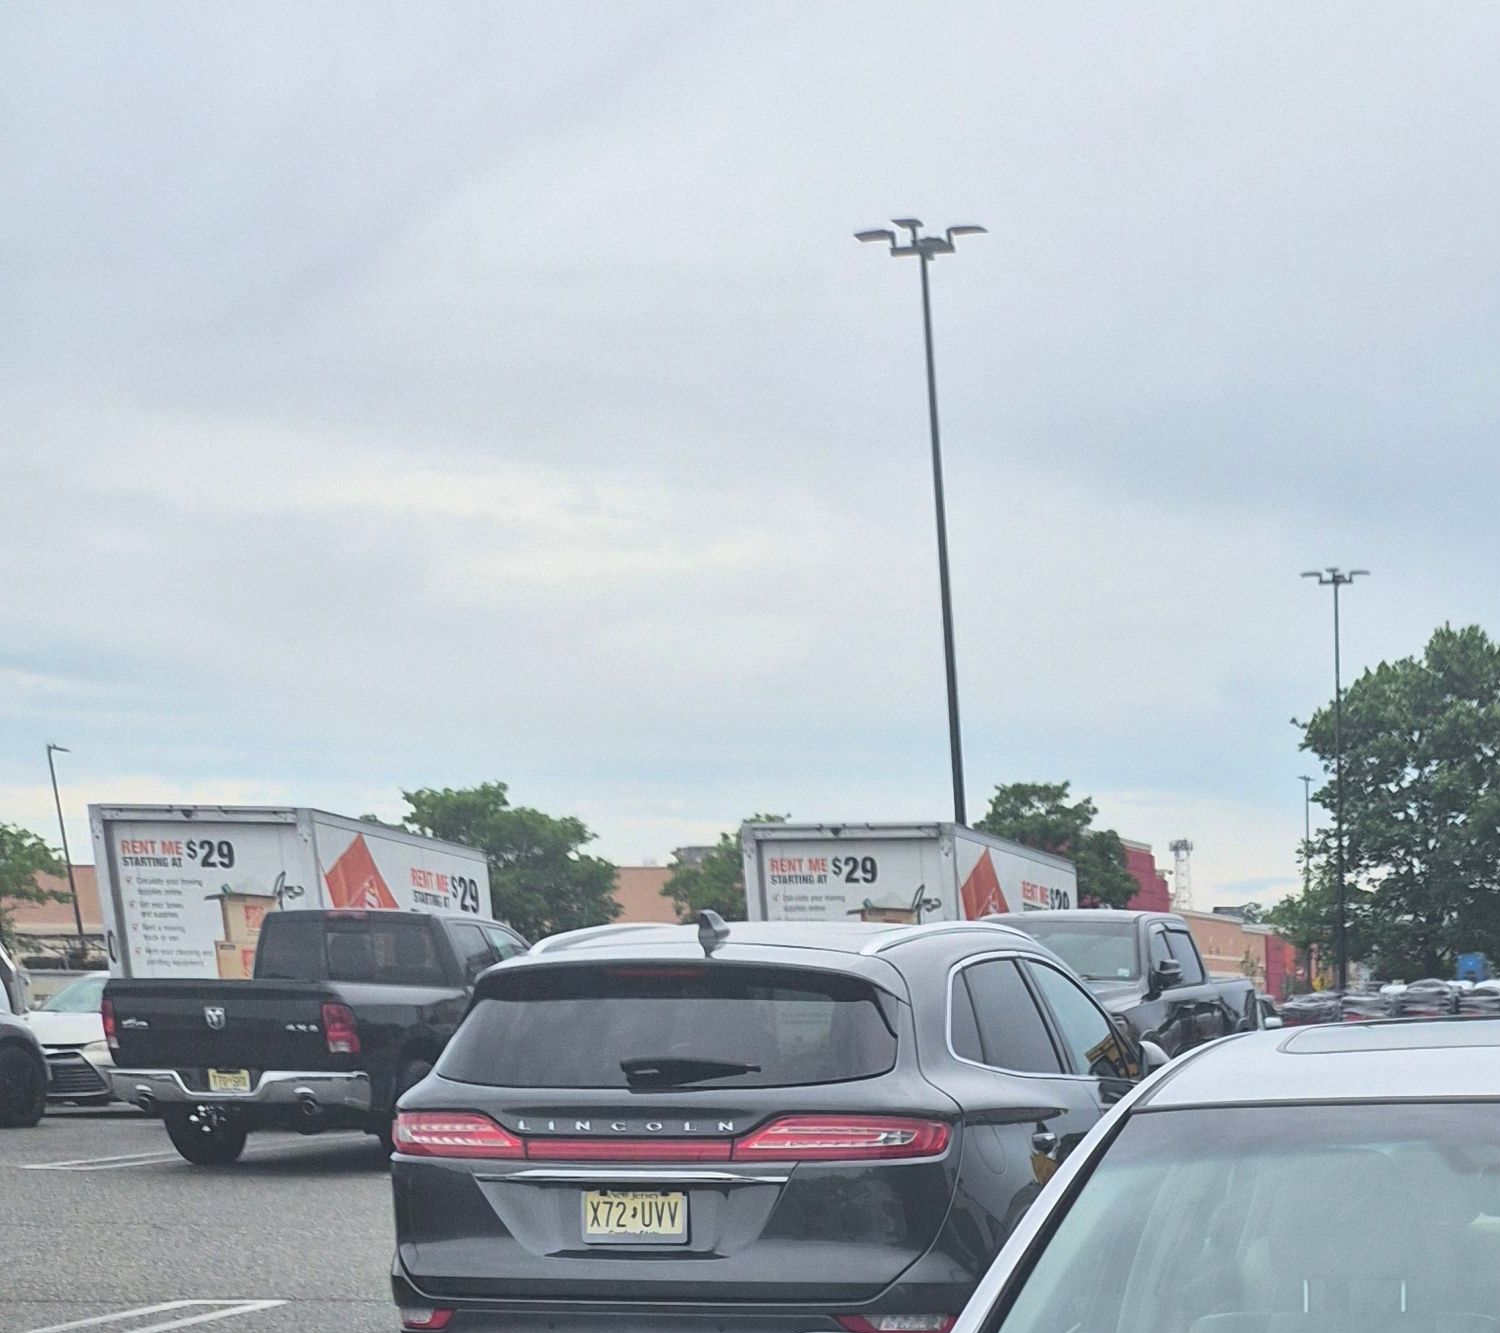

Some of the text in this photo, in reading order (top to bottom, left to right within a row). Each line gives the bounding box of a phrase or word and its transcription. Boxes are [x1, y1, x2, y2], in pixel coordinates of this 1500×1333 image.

[121, 839, 235, 869] RENT ME $29
[123, 857, 183, 868] STARTING AT
[770, 856, 878, 884] RENT ME $29
[771, 875, 828, 885] STARTING AT
[411, 868, 479, 914] RENT ME $29
[518, 1119, 734, 1132] LINCOLN
[590, 1201, 679, 1228] X72 UVV
